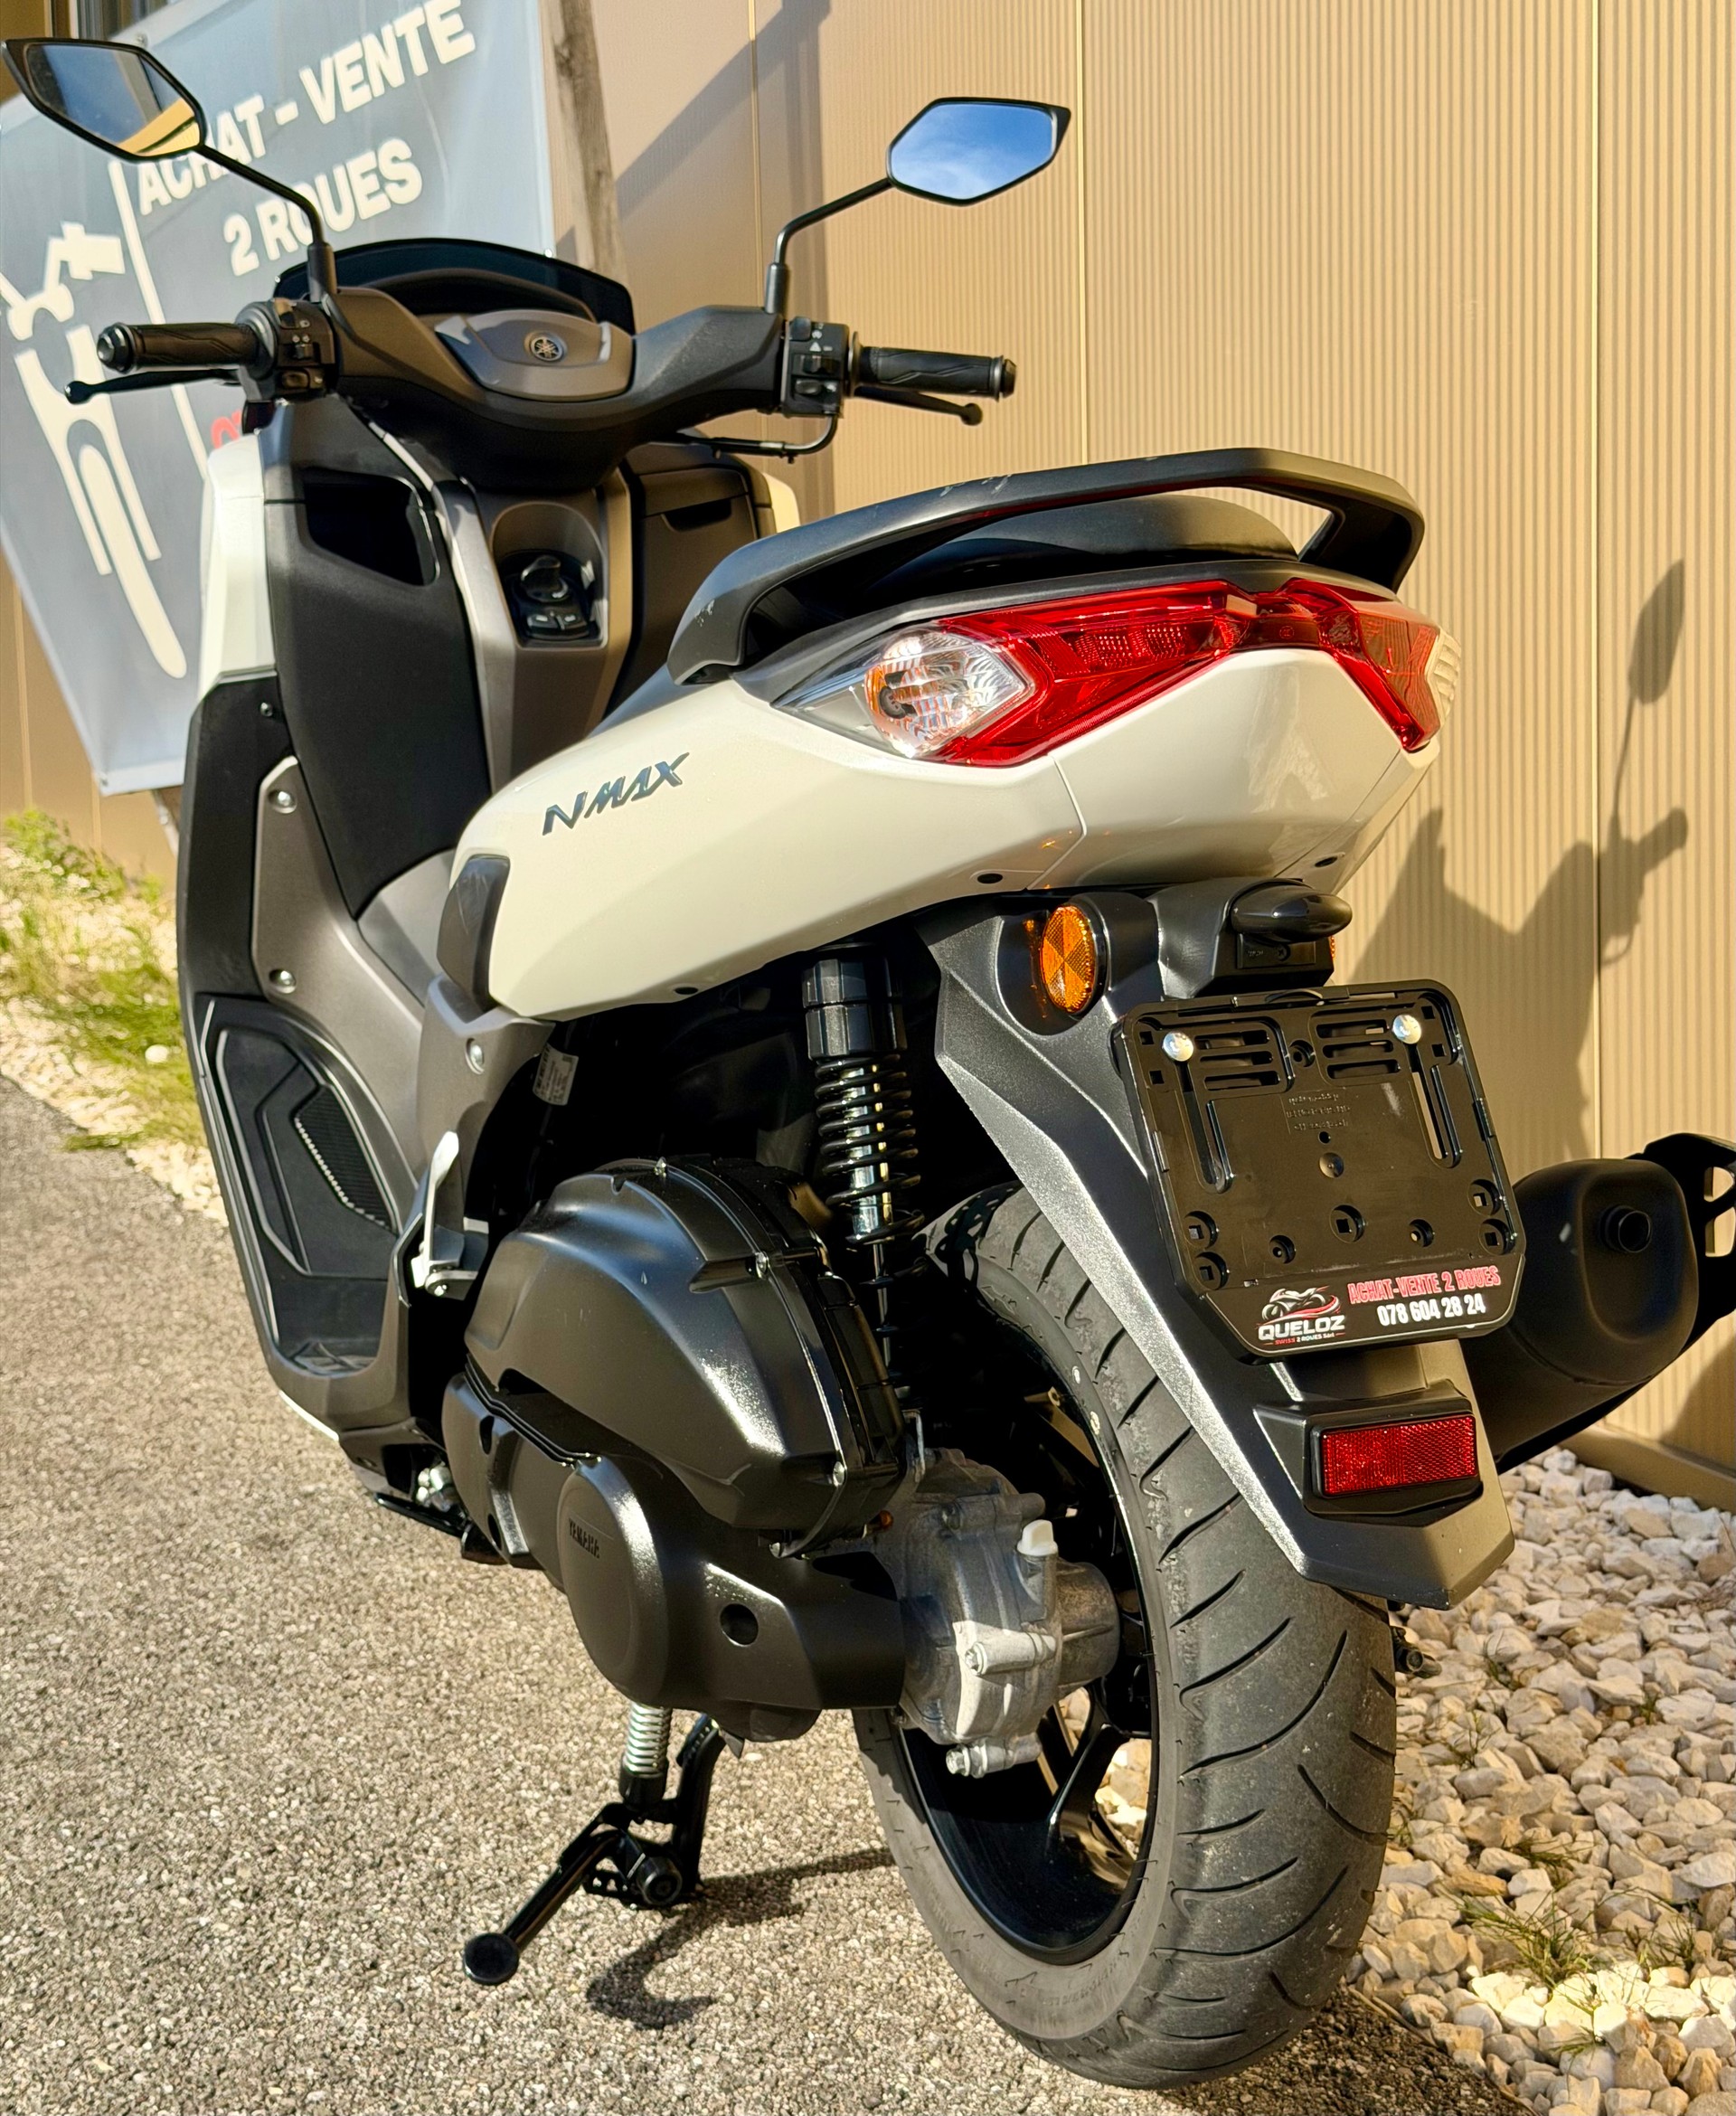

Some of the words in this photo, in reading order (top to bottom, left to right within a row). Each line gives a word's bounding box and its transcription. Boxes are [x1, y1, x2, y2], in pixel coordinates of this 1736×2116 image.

[138, 93, 266, 216] ACHAT
[298, 0, 476, 125] VENTE
[223, 212, 260, 277] 2
[255, 137, 423, 261] ROUES
[542, 751, 691, 836] NMAX
[1347, 1272, 1441, 1305] ACHAT-VENTE
[1440, 1271, 1456, 1292] 2
[1454, 1265, 1502, 1290] ROUES
[1376, 1302, 1409, 1327] 078
[1408, 1298, 1441, 1323] 604
[1440, 1295, 1462, 1318] 28
[1463, 1292, 1486, 1316] 24
[1258, 1315, 1345, 1341] QUELOZ
